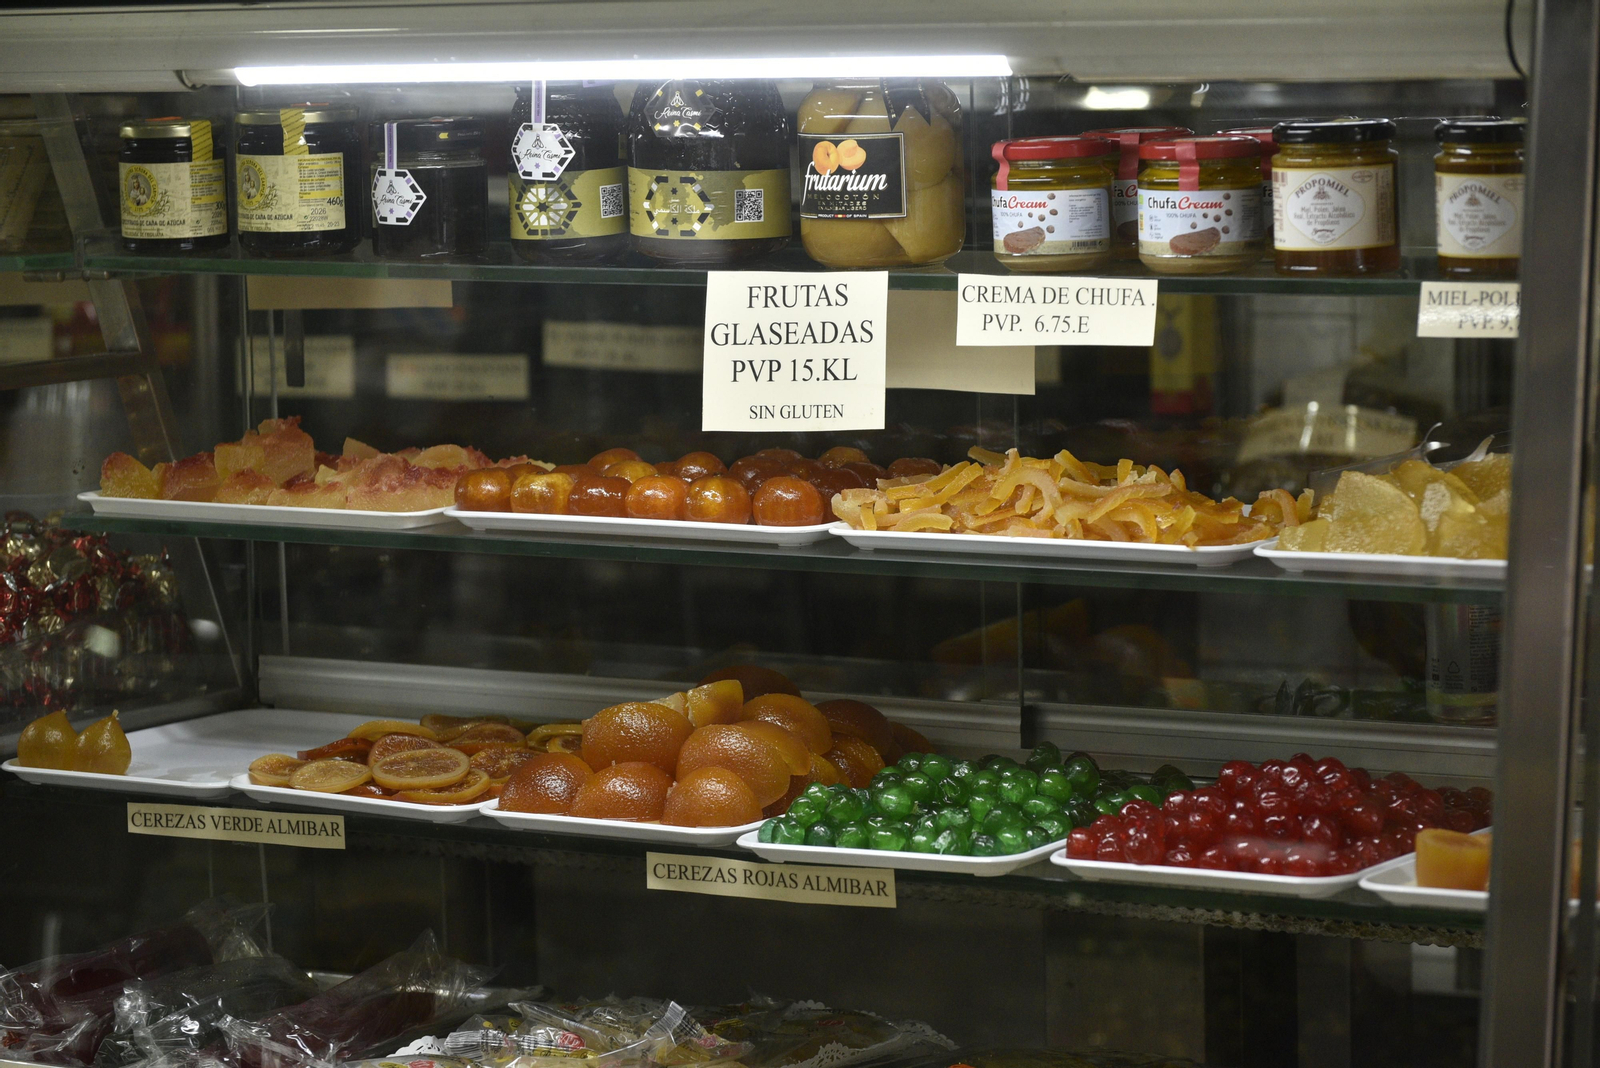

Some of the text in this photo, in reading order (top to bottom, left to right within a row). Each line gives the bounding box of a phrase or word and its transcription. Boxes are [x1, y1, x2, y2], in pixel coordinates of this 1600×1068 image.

[654, 107, 680, 119] Reina
[801, 160, 888, 206] frutarium
[1295, 177, 1350, 198] PROPOMIEL
[327, 197, 343, 207] 460g
[1007, 195, 1048, 209] Cream
[1148, 196, 1224, 210] Chufa Cream
[747, 283, 848, 308] FRUTAS
[962, 284, 1036, 304] CREMA
[1043, 286, 1070, 304] DE
[710, 320, 873, 346] GLASEADAS
[982, 313, 1090, 333] PVP. 6.75.E
[731, 358, 857, 382] PVP 15.KL
[749, 404, 844, 419] SIN GLUTEN
[131, 810, 342, 837] CEREZAS VERDE ALMIBAR
[653, 863, 889, 897] CEREZAS ROJAS ALMIBAR
